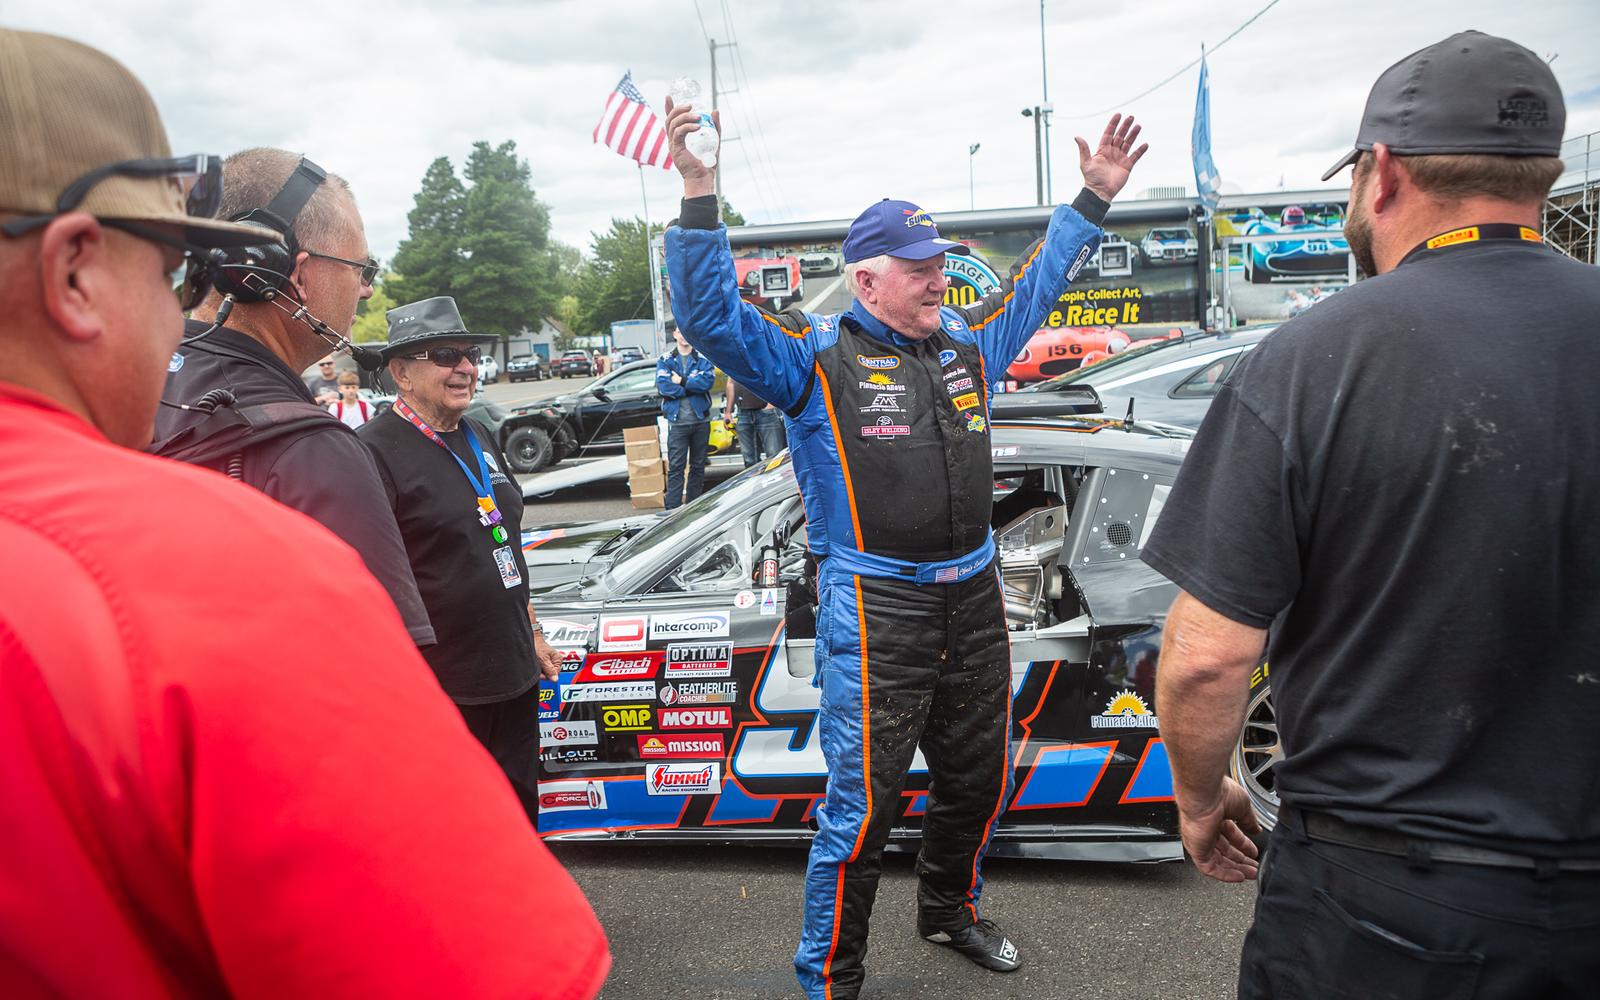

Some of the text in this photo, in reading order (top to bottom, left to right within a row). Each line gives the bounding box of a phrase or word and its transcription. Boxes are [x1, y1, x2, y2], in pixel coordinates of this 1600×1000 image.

[1059, 287, 1142, 304] eople Collect Art,
[1066, 305, 1118, 326] Race
[1122, 302, 1140, 323] It
[1048, 344, 1083, 357] 156
[671, 646, 727, 661] OPTIMA
[592, 657, 652, 676] Eibach
[586, 685, 654, 694] FORESTER
[678, 682, 737, 695] FEATHERLITE
[679, 695, 707, 703] COACHES
[603, 709, 651, 727] OMP
[662, 710, 729, 727] MOTUL
[1091, 715, 1136, 728] Pinnacle
[539, 750, 596, 761] HILLOUT
